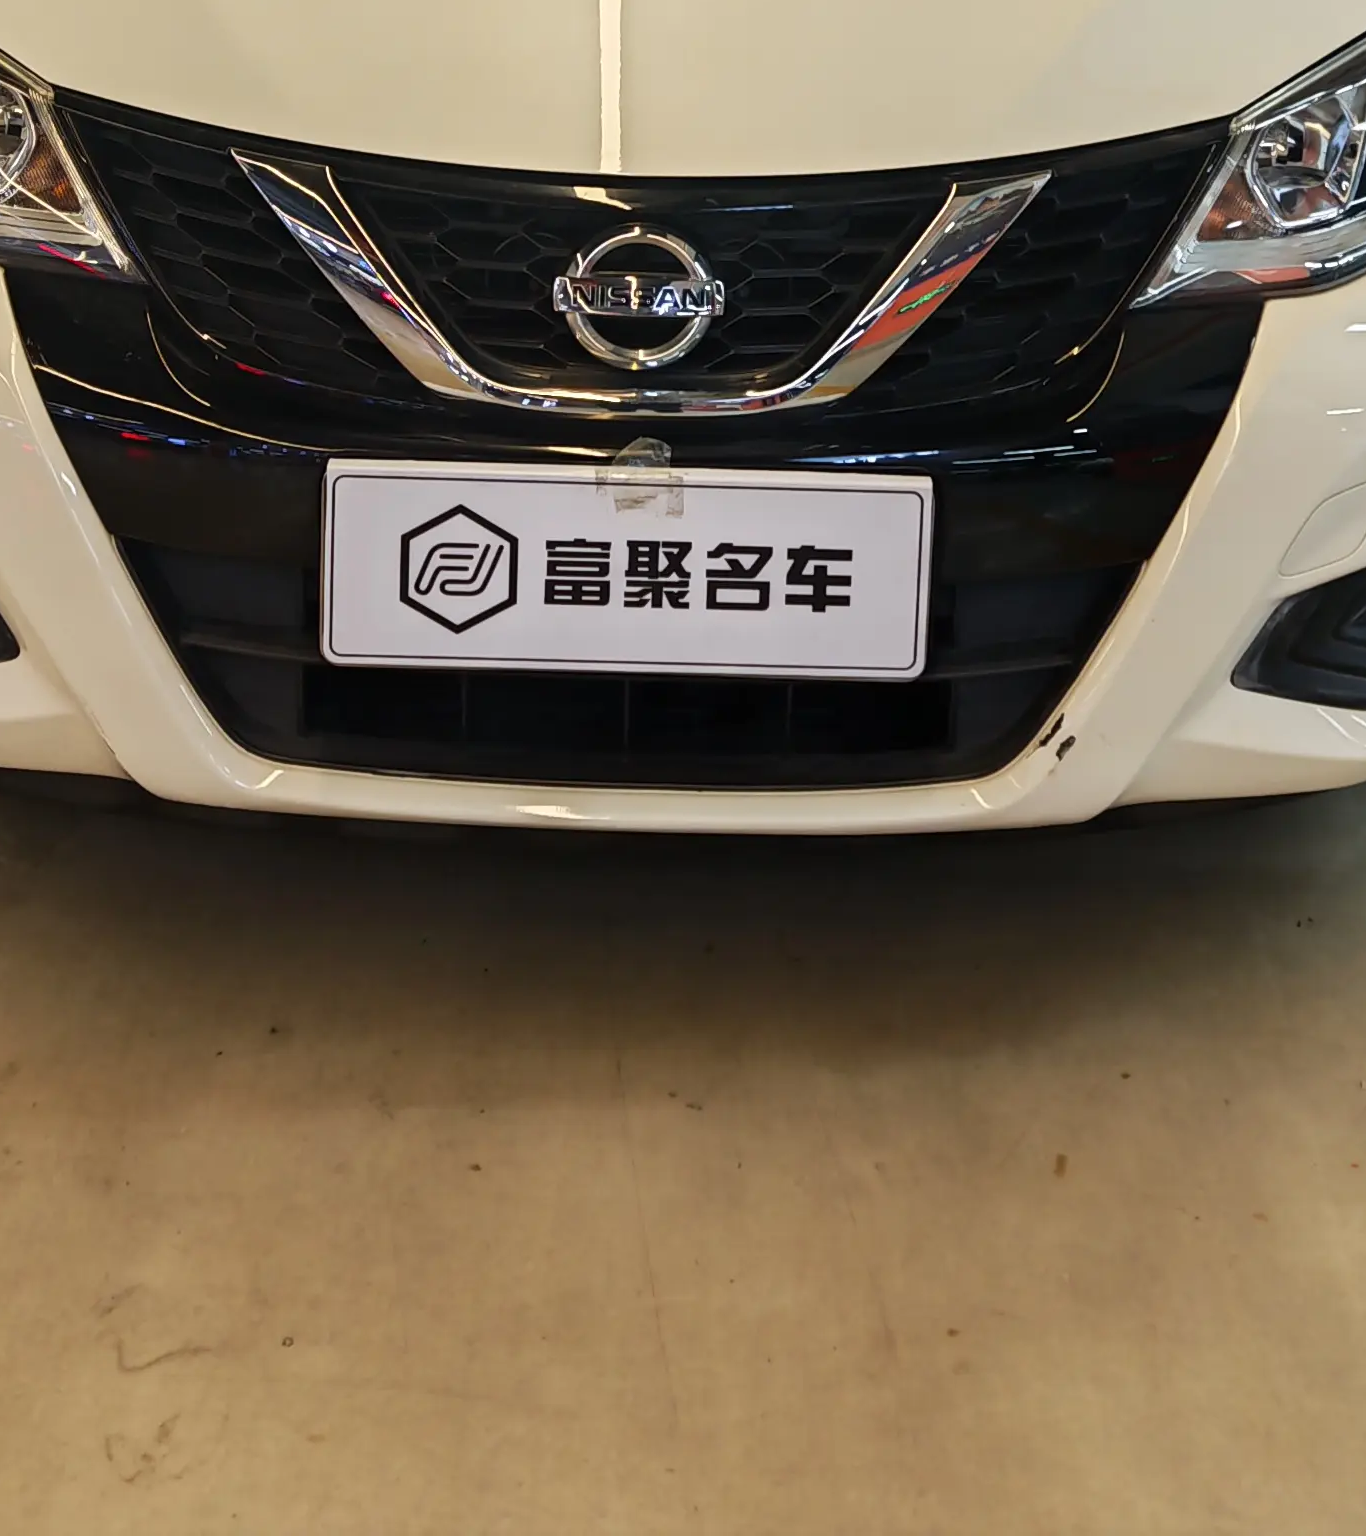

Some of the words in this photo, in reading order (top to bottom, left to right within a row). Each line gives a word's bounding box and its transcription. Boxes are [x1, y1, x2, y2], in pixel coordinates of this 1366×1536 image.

[571, 284, 709, 311] NISSAN
[543, 537, 854, 613] 富聚名车
